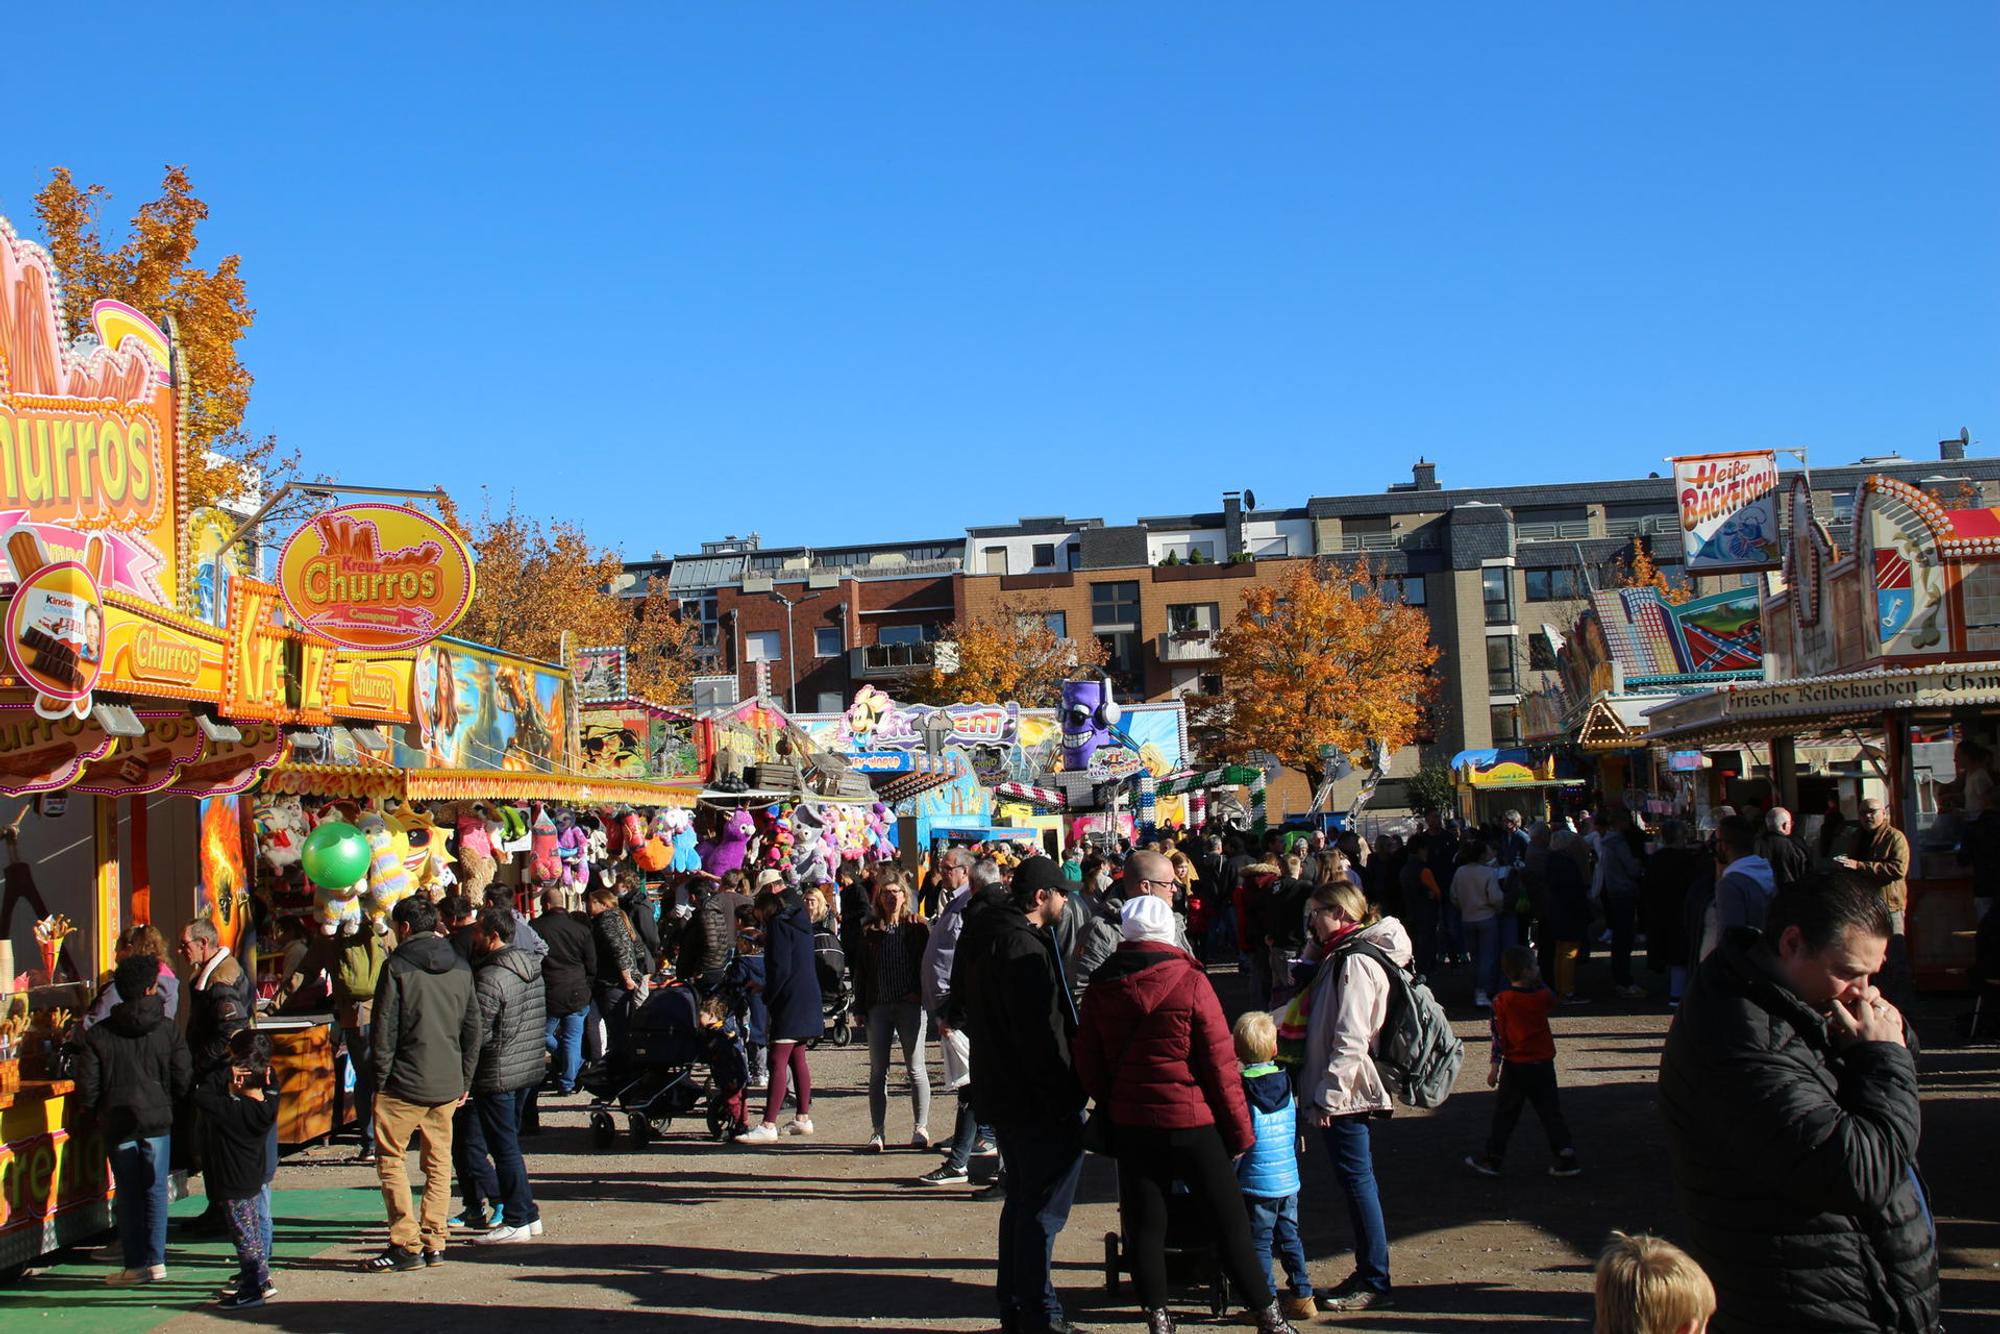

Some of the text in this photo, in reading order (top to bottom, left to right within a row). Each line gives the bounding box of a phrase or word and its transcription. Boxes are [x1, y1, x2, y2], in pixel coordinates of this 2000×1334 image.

[1683, 461, 1750, 489] Heißer
[1682, 471, 1773, 531] BACKFISCH
[304, 561, 436, 604] Churros
[342, 556, 381, 573] Kreuz
[137, 629, 197, 673] Churros
[352, 662, 392, 700] Churros
[953, 712, 1003, 733] EAT
